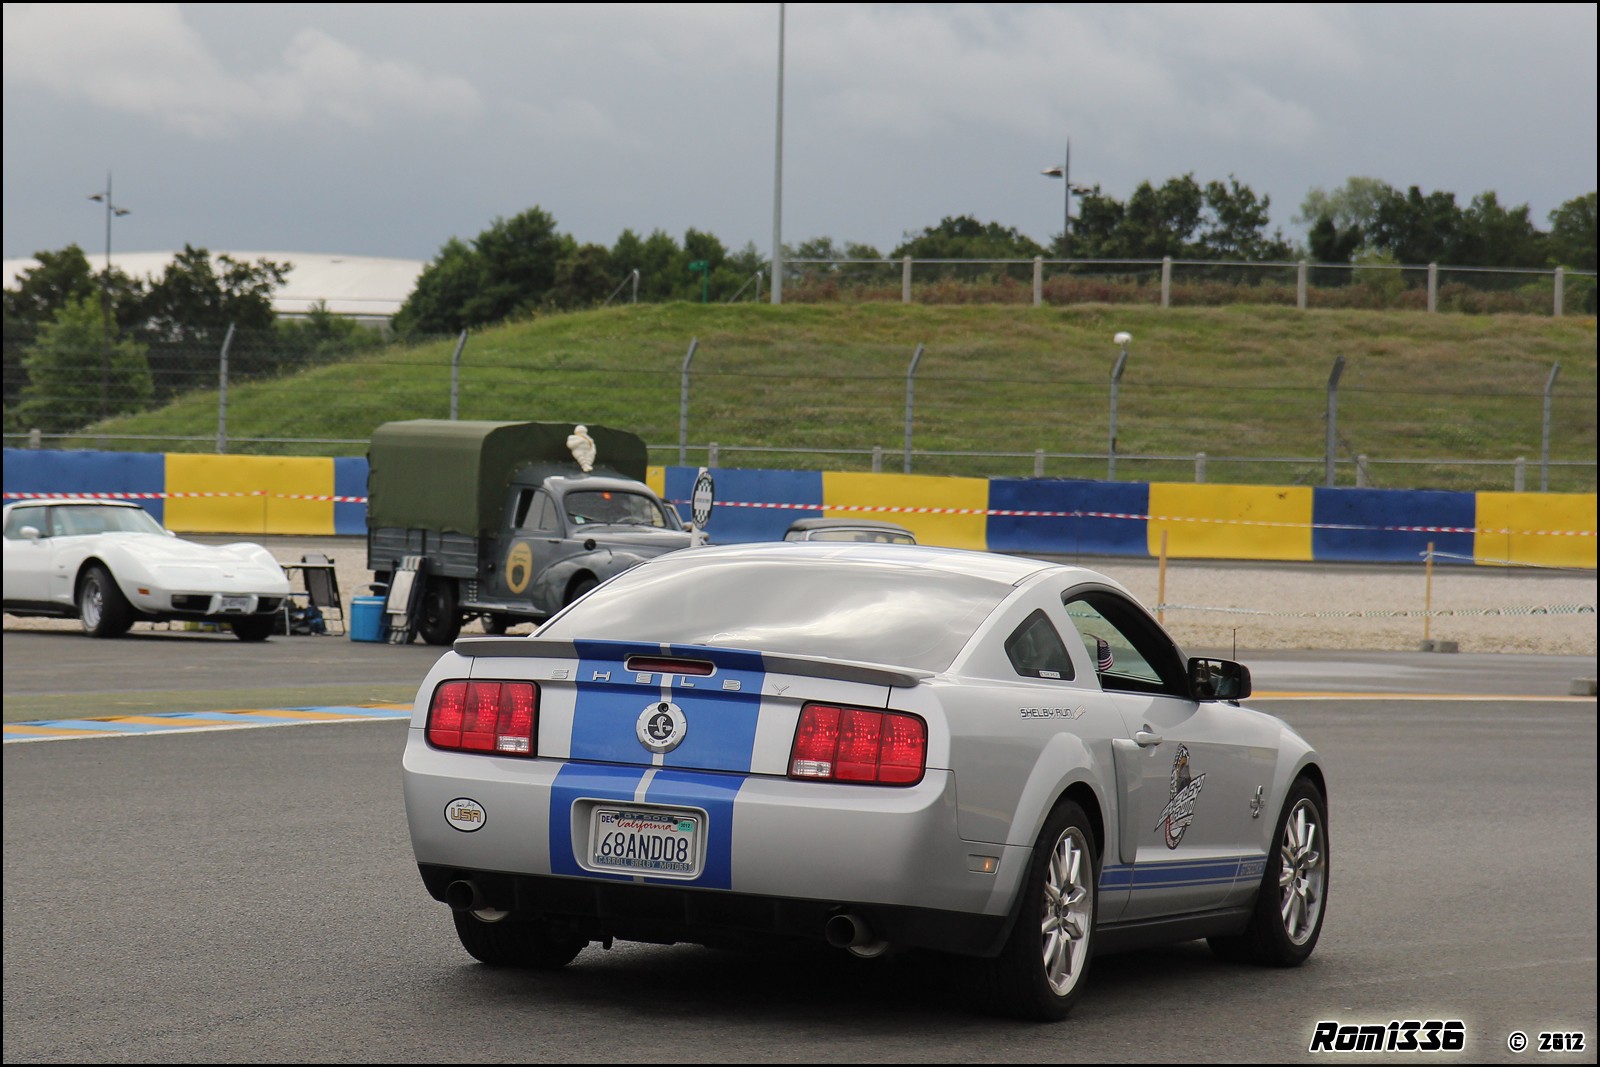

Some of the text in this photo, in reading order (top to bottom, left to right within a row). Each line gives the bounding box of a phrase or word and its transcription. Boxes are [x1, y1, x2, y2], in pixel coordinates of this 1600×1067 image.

[551, 669, 790, 696] SHELBY
[1020, 707, 1054, 718] SHELBY
[451, 807, 481, 823] USA
[601, 815, 615, 824] DEC
[617, 819, 679, 832] California
[601, 832, 689, 863] 68AND08
[598, 857, 688, 871] CARROLL SHELBY MOTORS
